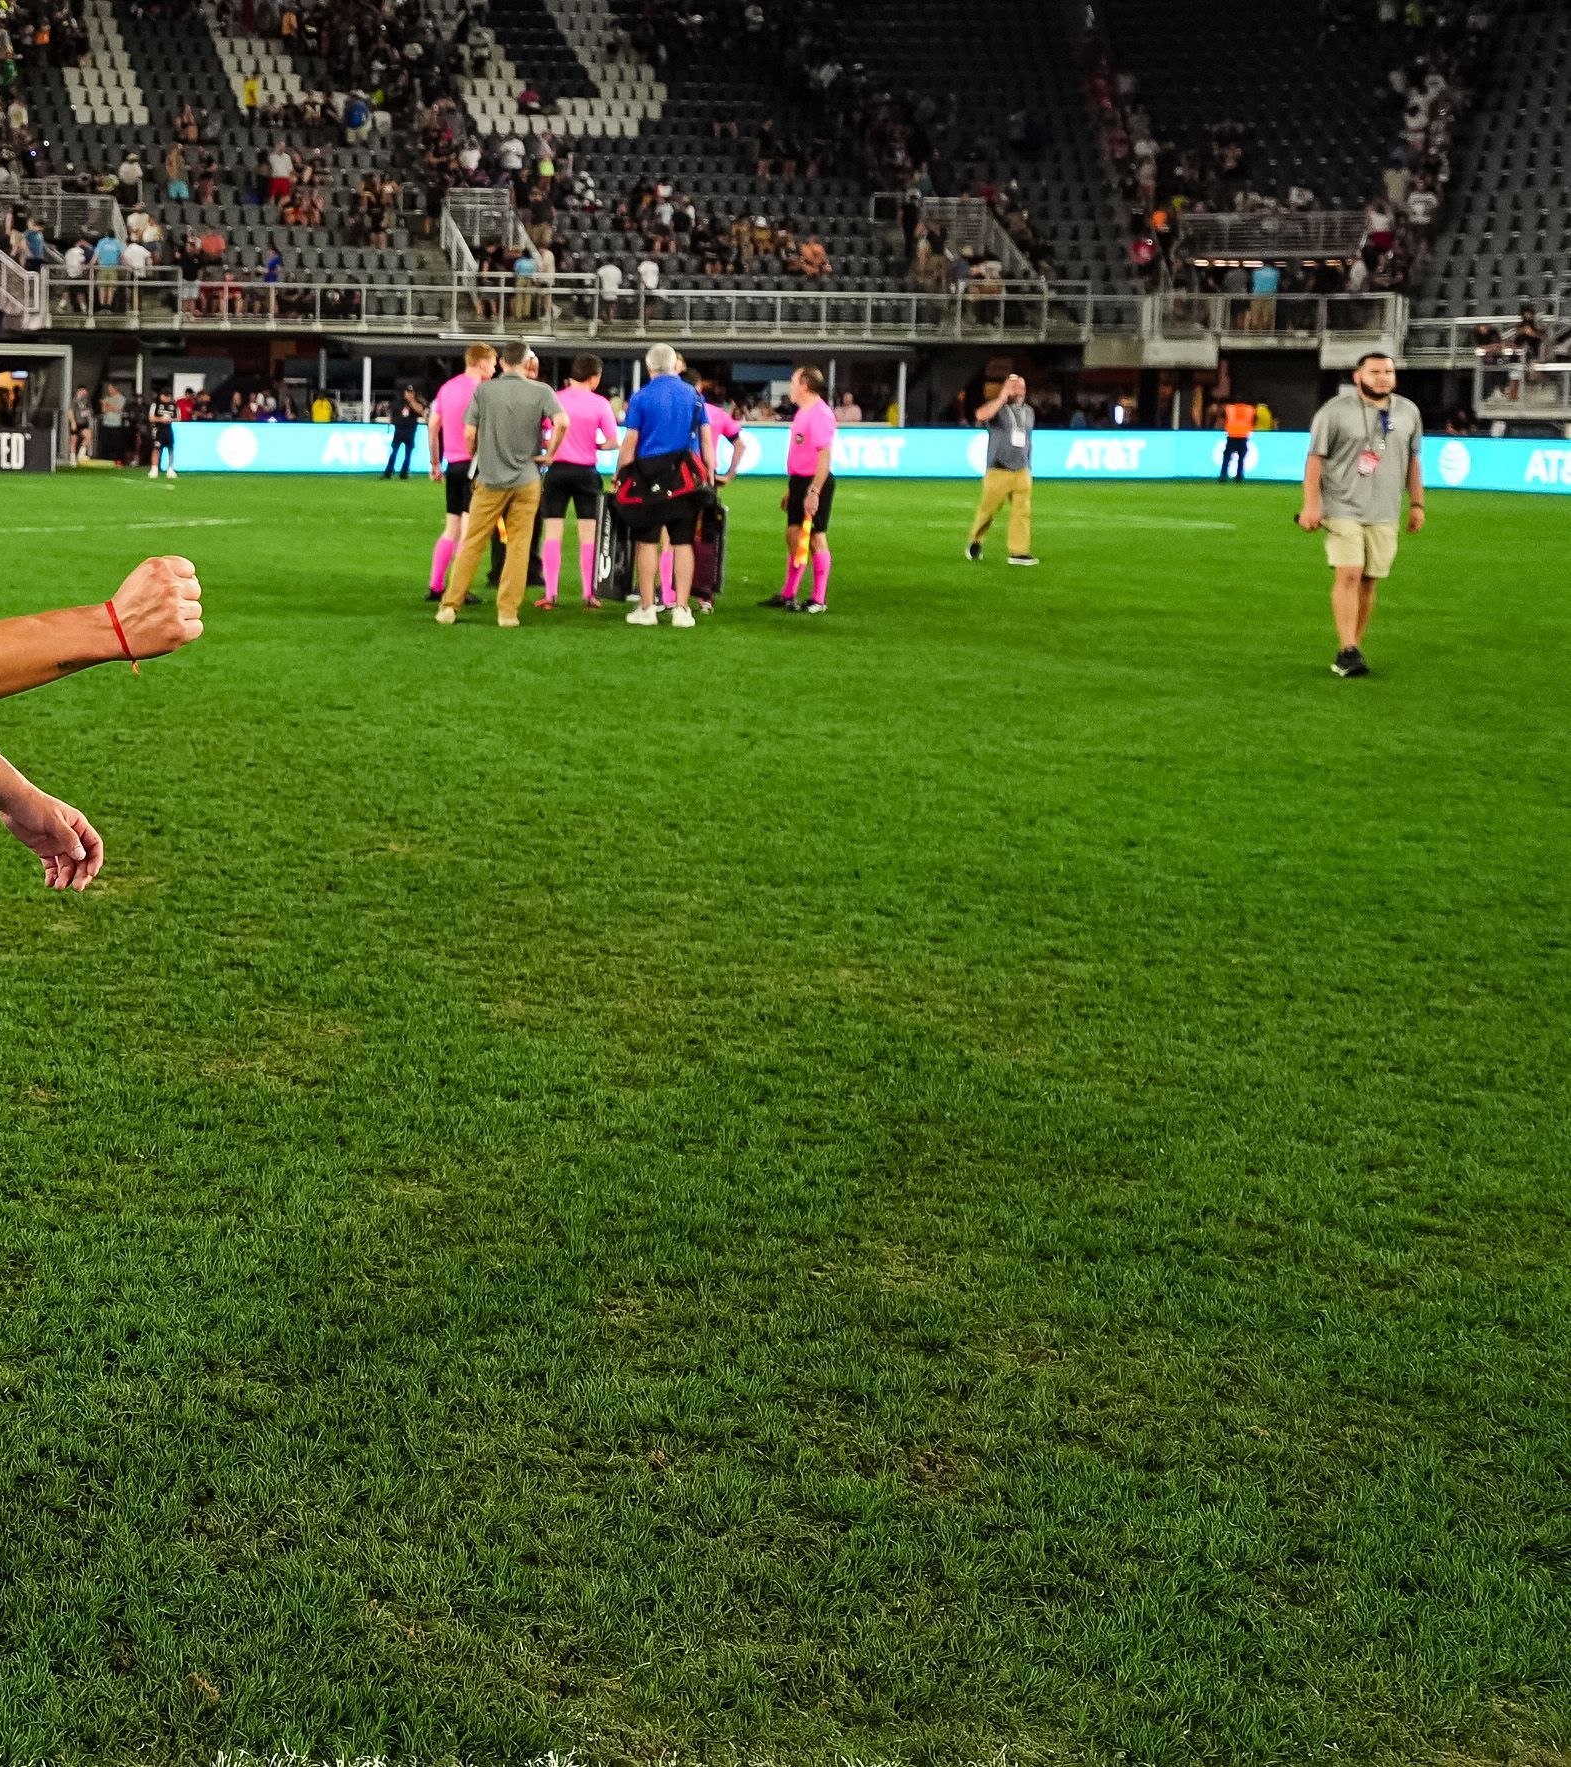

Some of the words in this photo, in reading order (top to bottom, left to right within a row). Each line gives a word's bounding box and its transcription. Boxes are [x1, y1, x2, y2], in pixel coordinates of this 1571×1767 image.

[322, 432, 393, 465] AT&
[832, 436, 905, 468] AT&T
[1065, 438, 1147, 470] AT&T
